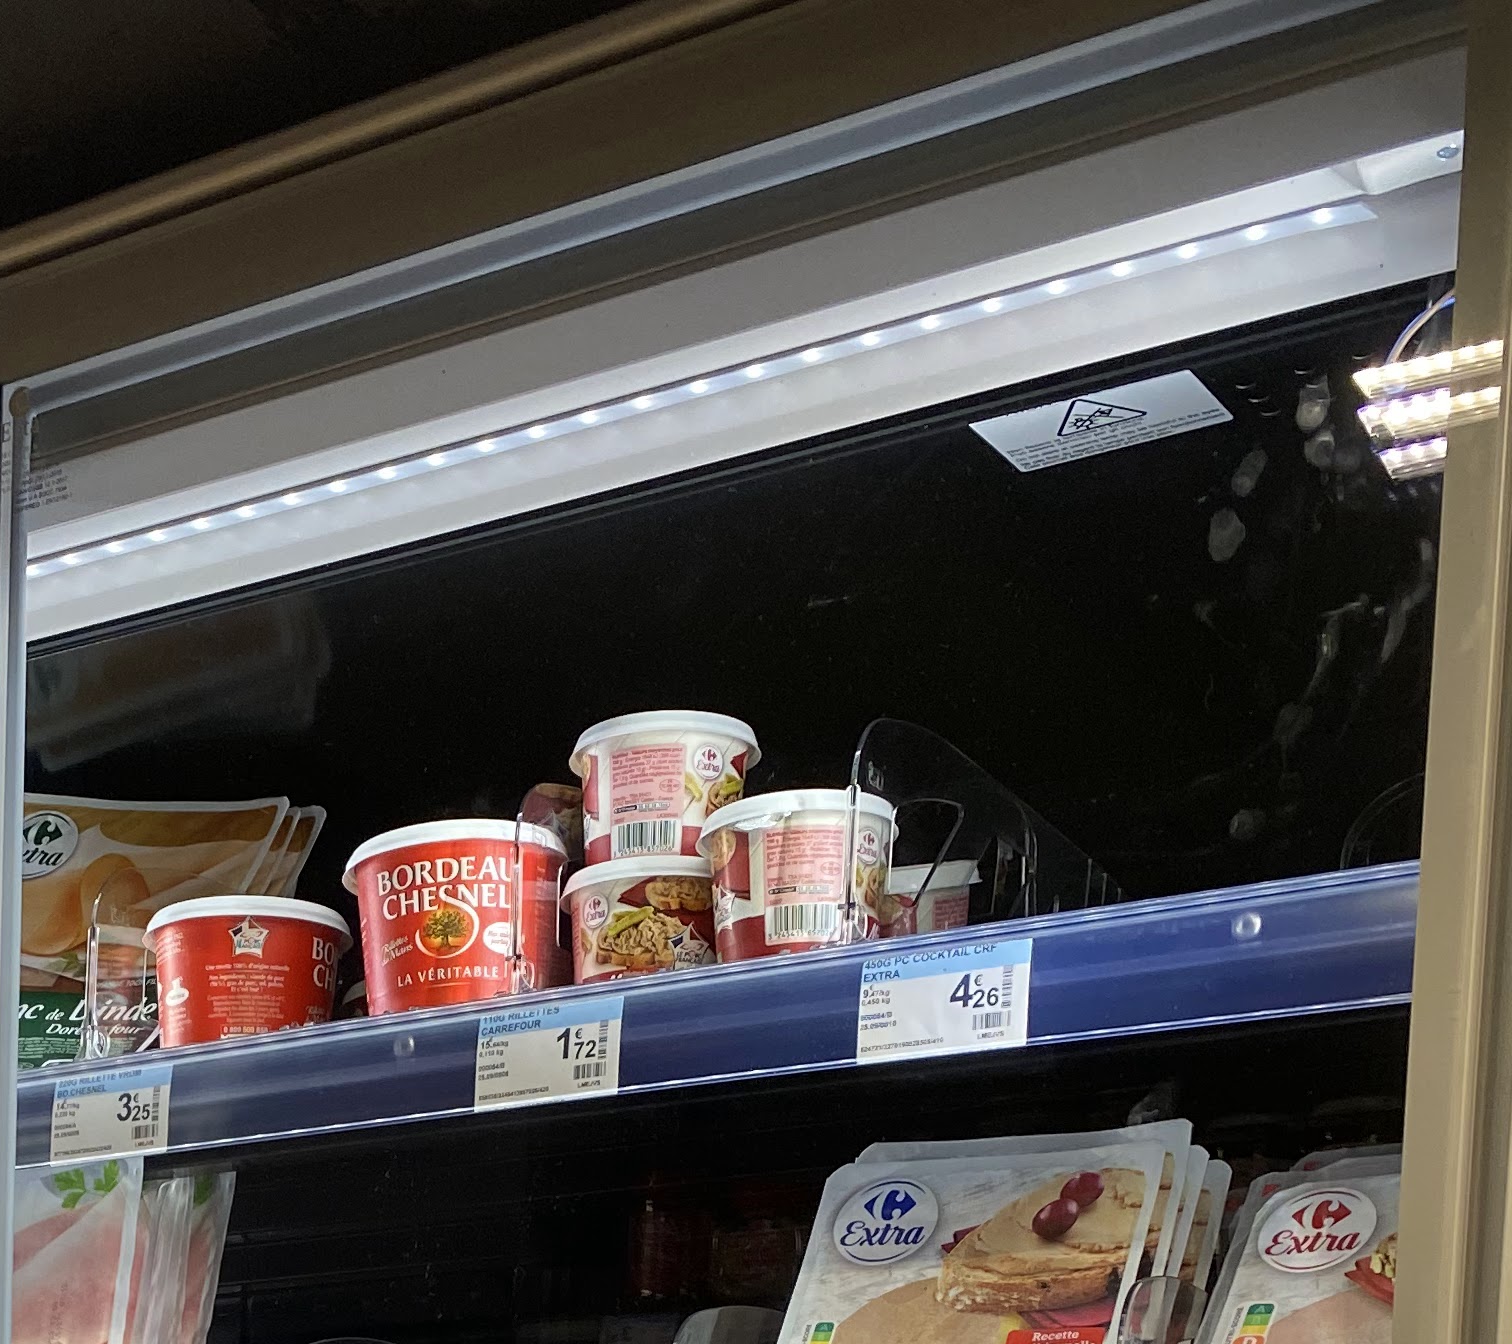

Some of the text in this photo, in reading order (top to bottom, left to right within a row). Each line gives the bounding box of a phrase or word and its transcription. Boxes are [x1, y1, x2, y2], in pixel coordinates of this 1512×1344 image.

[382, 884, 511, 921] CHESNEL
[397, 965, 499, 988] LA VÉRITABLE
[863, 971, 900, 983] EXTRA
[481, 1020, 541, 1036] CARREFOUR
[840, 1220, 926, 1249] Extra
[1264, 1229, 1360, 1256] Extra
[1032, 1329, 1079, 1343] Recette
